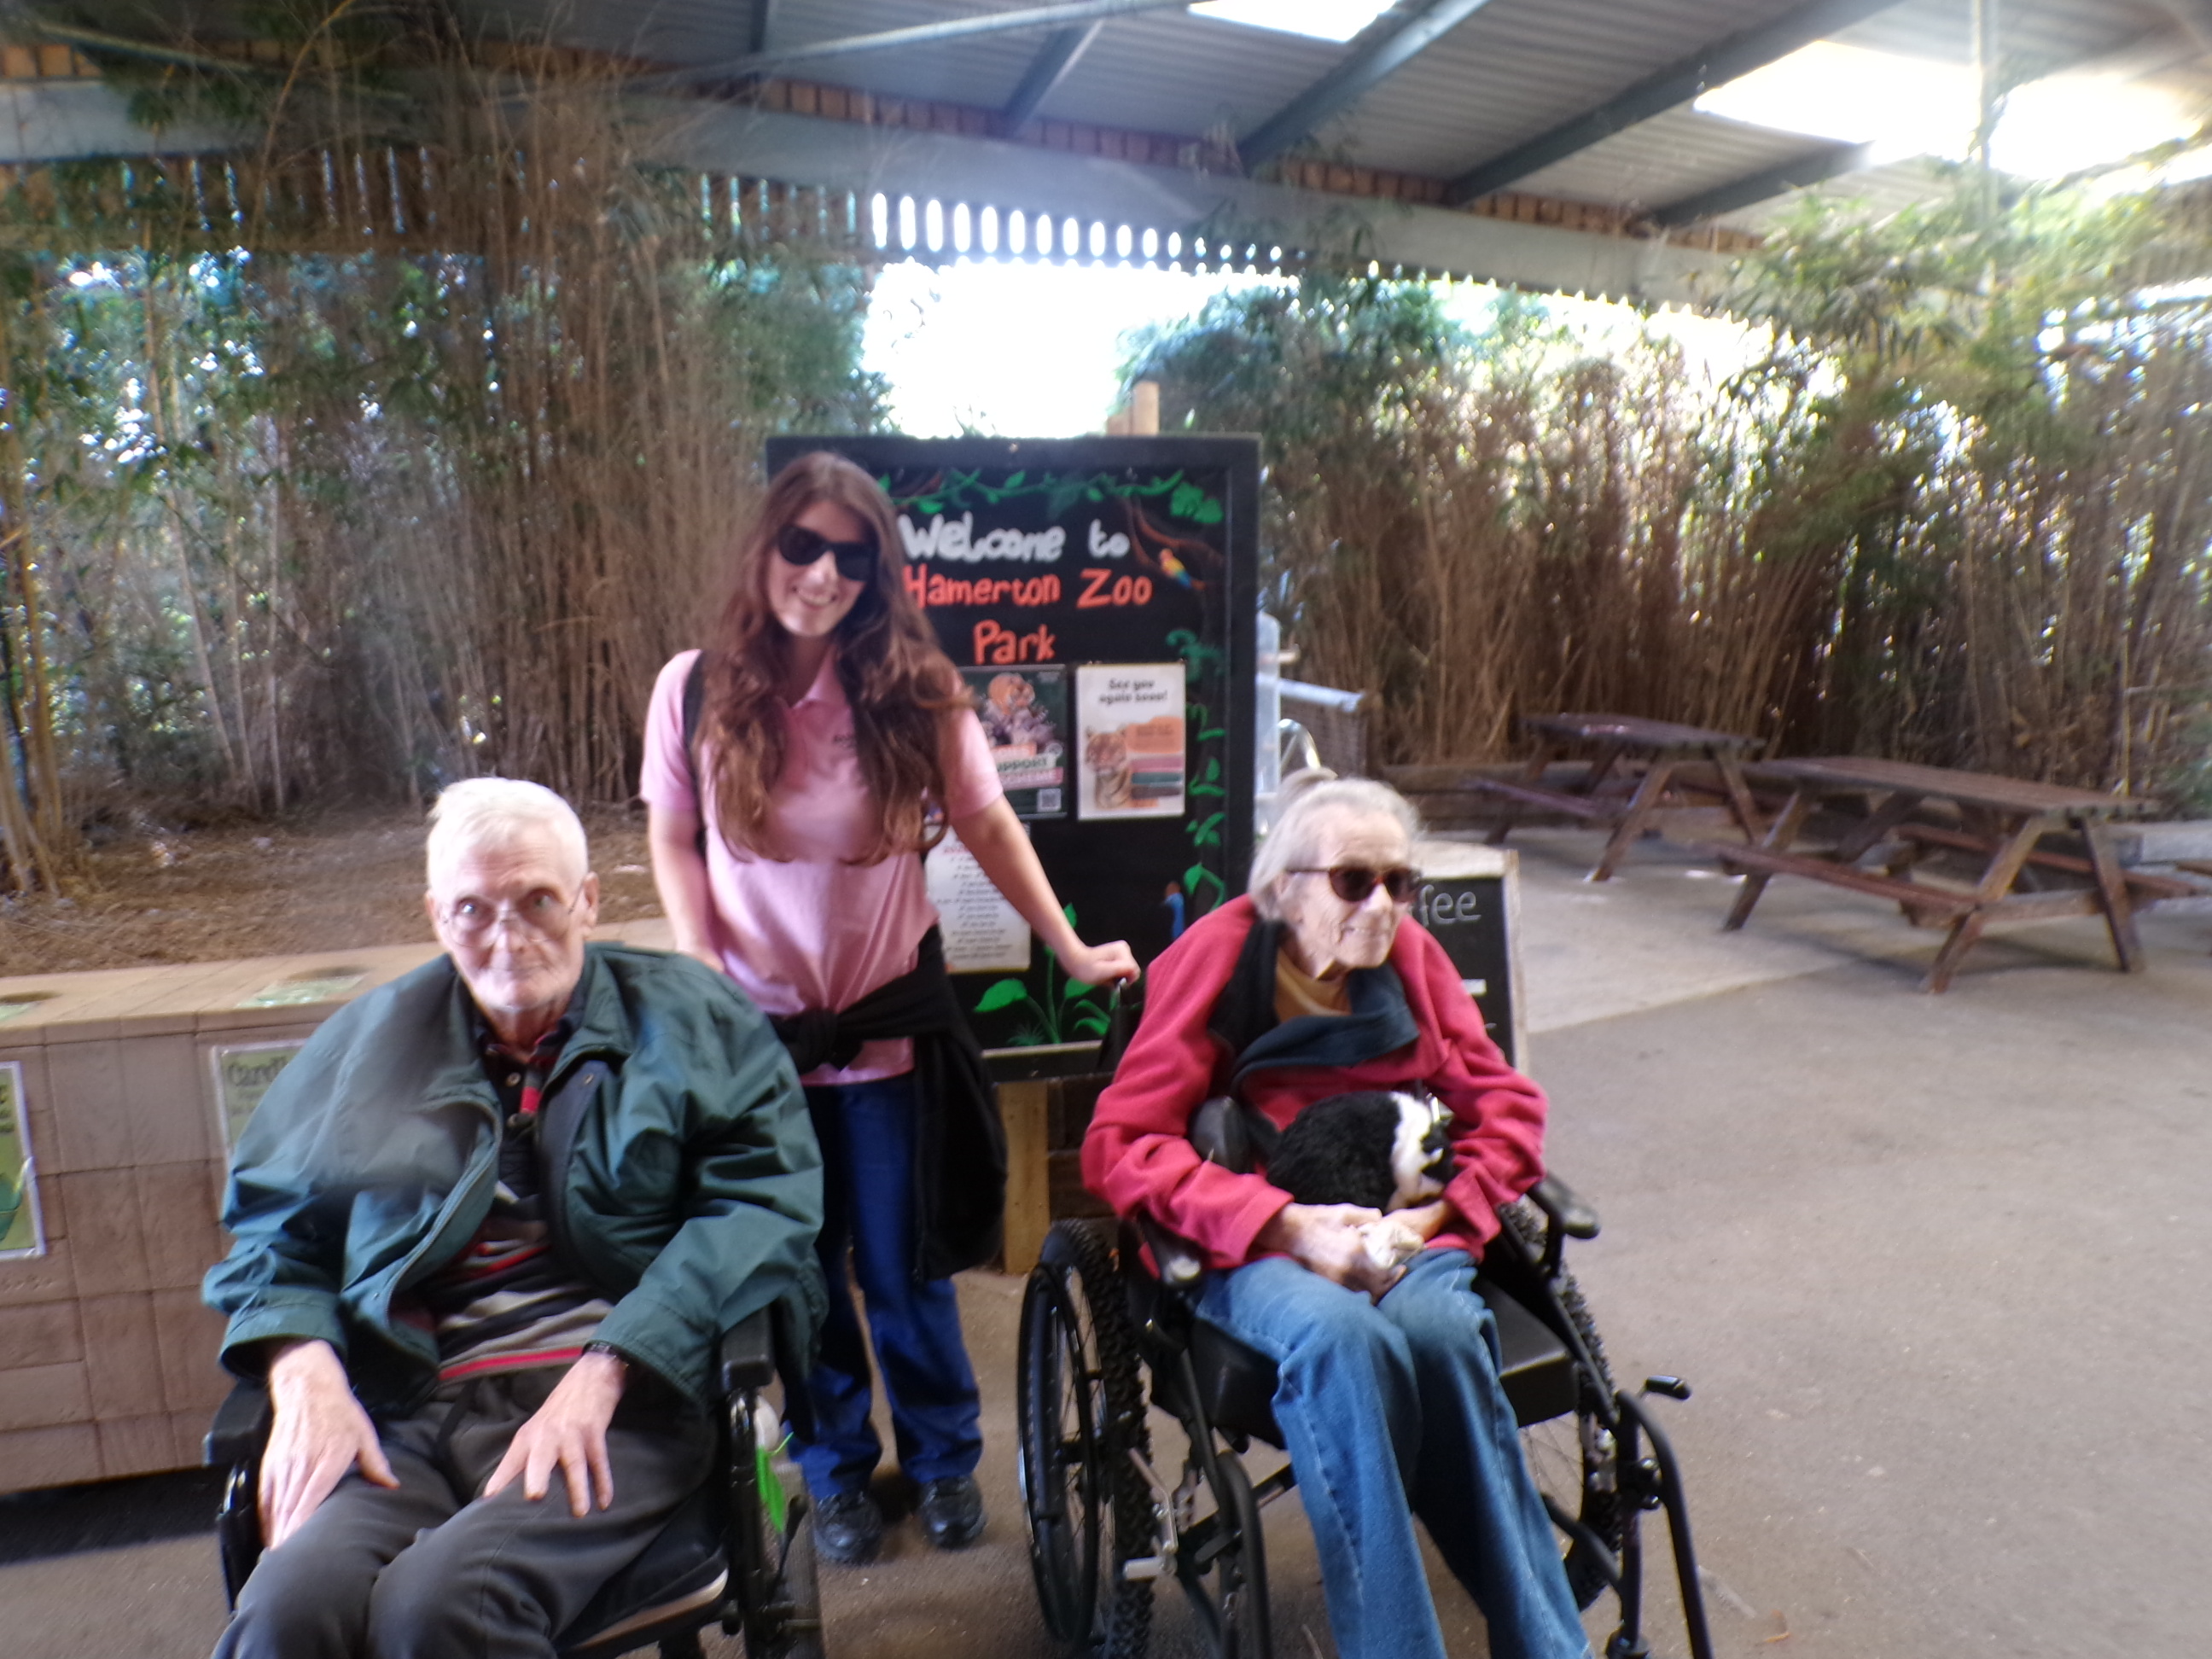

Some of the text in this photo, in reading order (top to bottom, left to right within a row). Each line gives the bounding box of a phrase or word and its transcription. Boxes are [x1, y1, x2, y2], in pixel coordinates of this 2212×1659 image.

[898, 510, 1131, 563] Welcome to
[902, 563, 1152, 609] Hamerton Zoo
[973, 619, 1056, 665] Park
